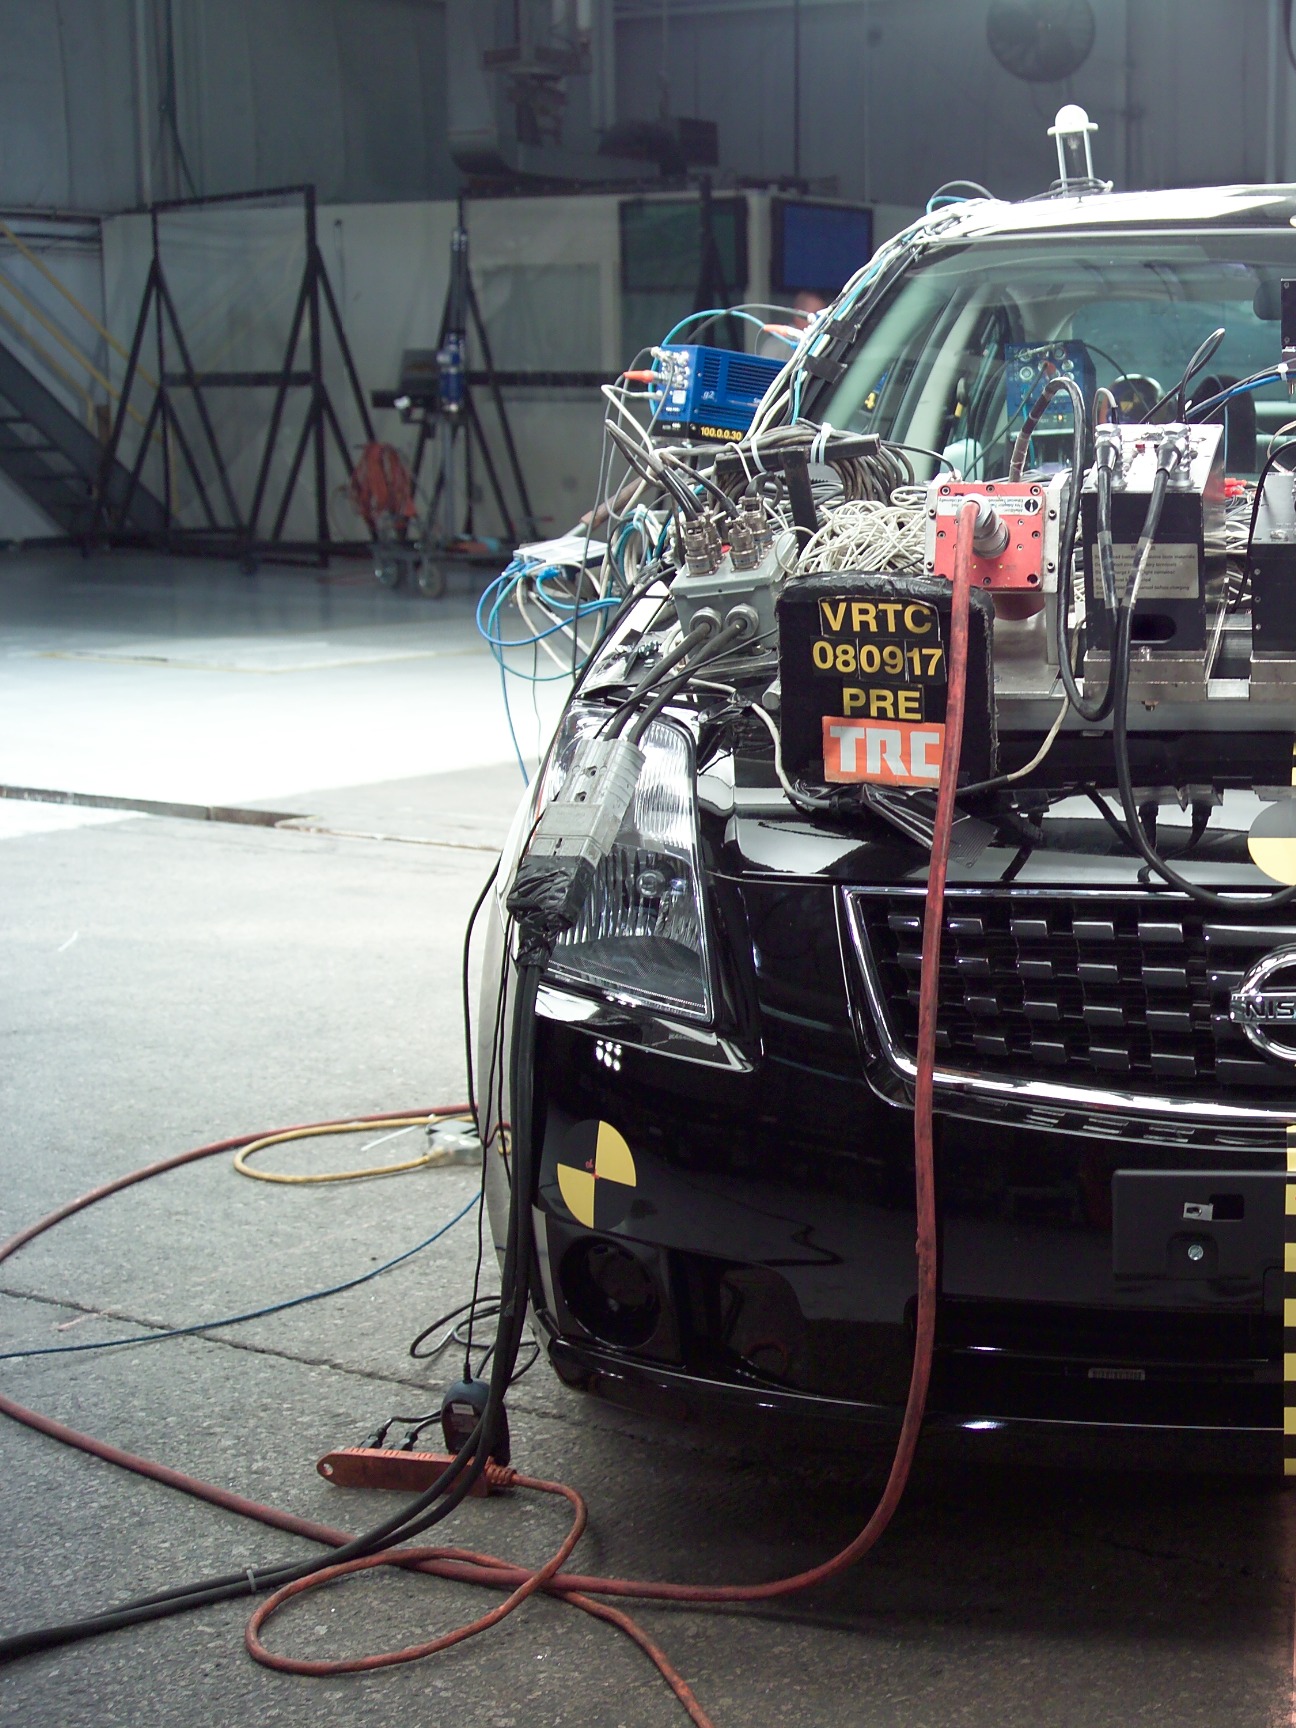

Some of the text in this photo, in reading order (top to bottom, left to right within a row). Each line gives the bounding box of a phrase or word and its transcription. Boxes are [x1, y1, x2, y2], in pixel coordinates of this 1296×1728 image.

[700, 426, 743, 441] 100.0.0.30
[822, 602, 932, 634] VRTC
[813, 641, 943, 676] 080917
[843, 687, 922, 720] PRE
[829, 725, 940, 779] TRC
